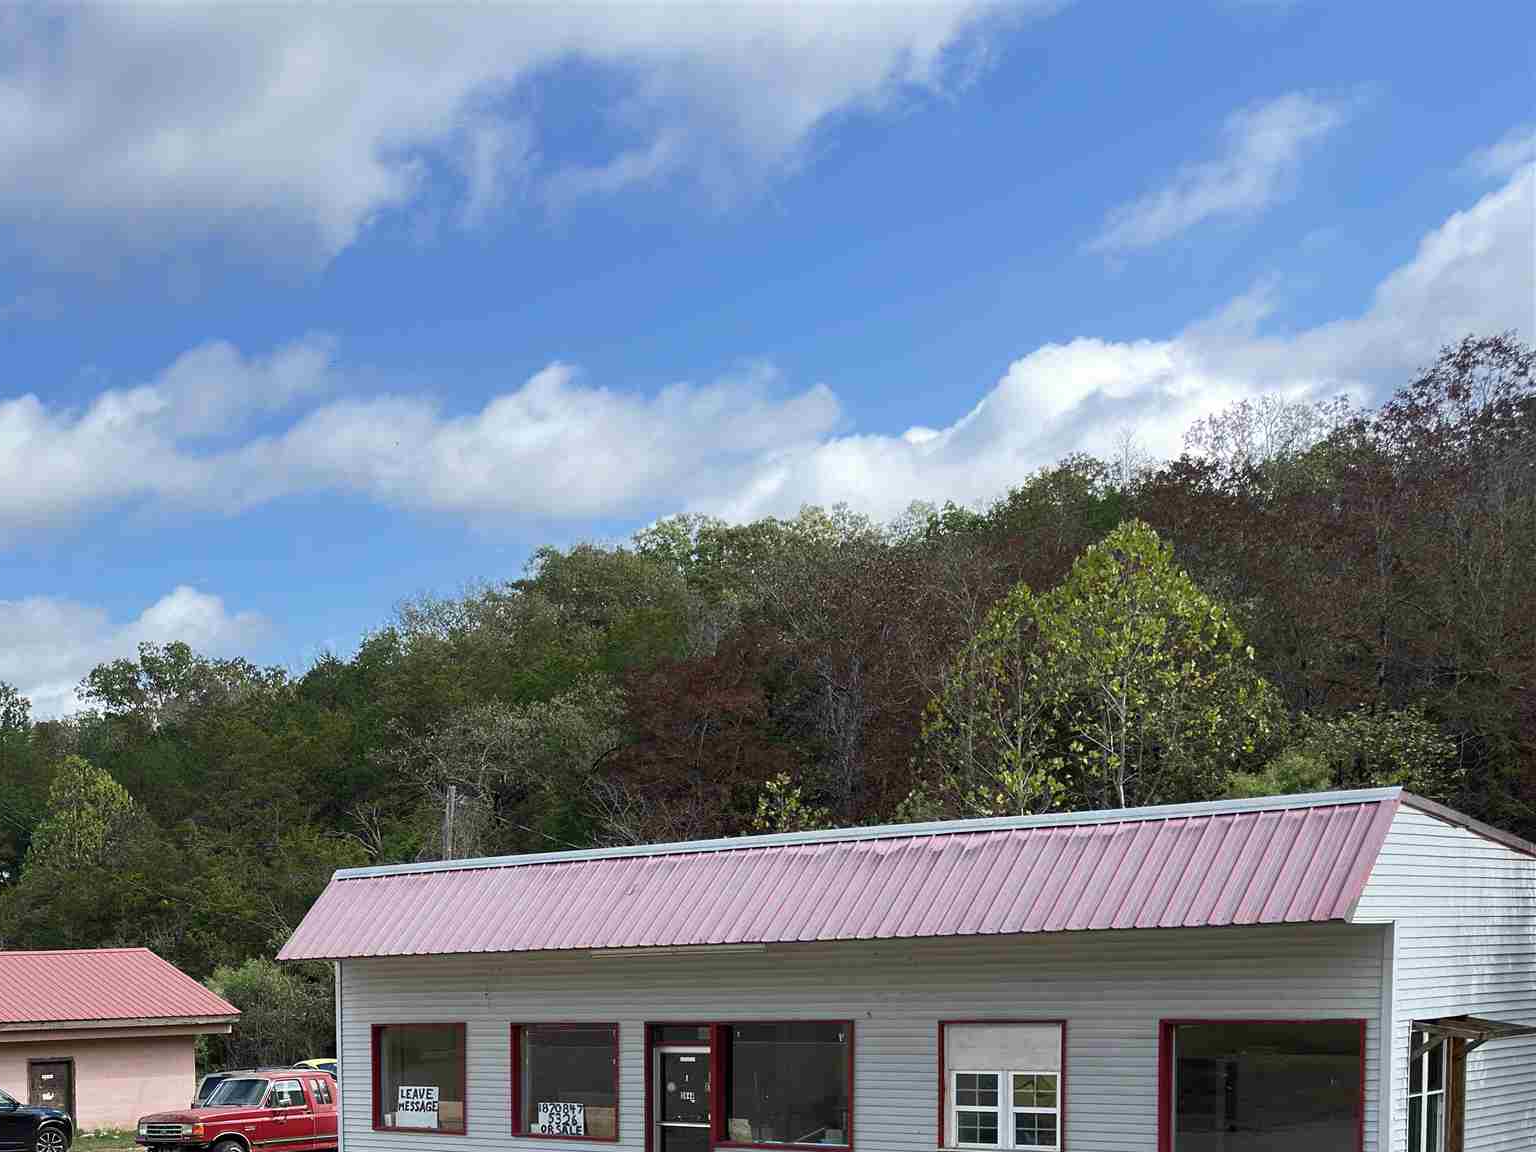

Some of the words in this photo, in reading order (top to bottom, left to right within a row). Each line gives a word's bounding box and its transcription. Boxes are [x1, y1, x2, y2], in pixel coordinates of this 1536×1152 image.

[400, 1087, 434, 1099] LEAVE
[398, 1100, 439, 1112] MESSAGE
[548, 1113, 578, 1126] 5326
[556, 1124, 582, 1136] SALE
